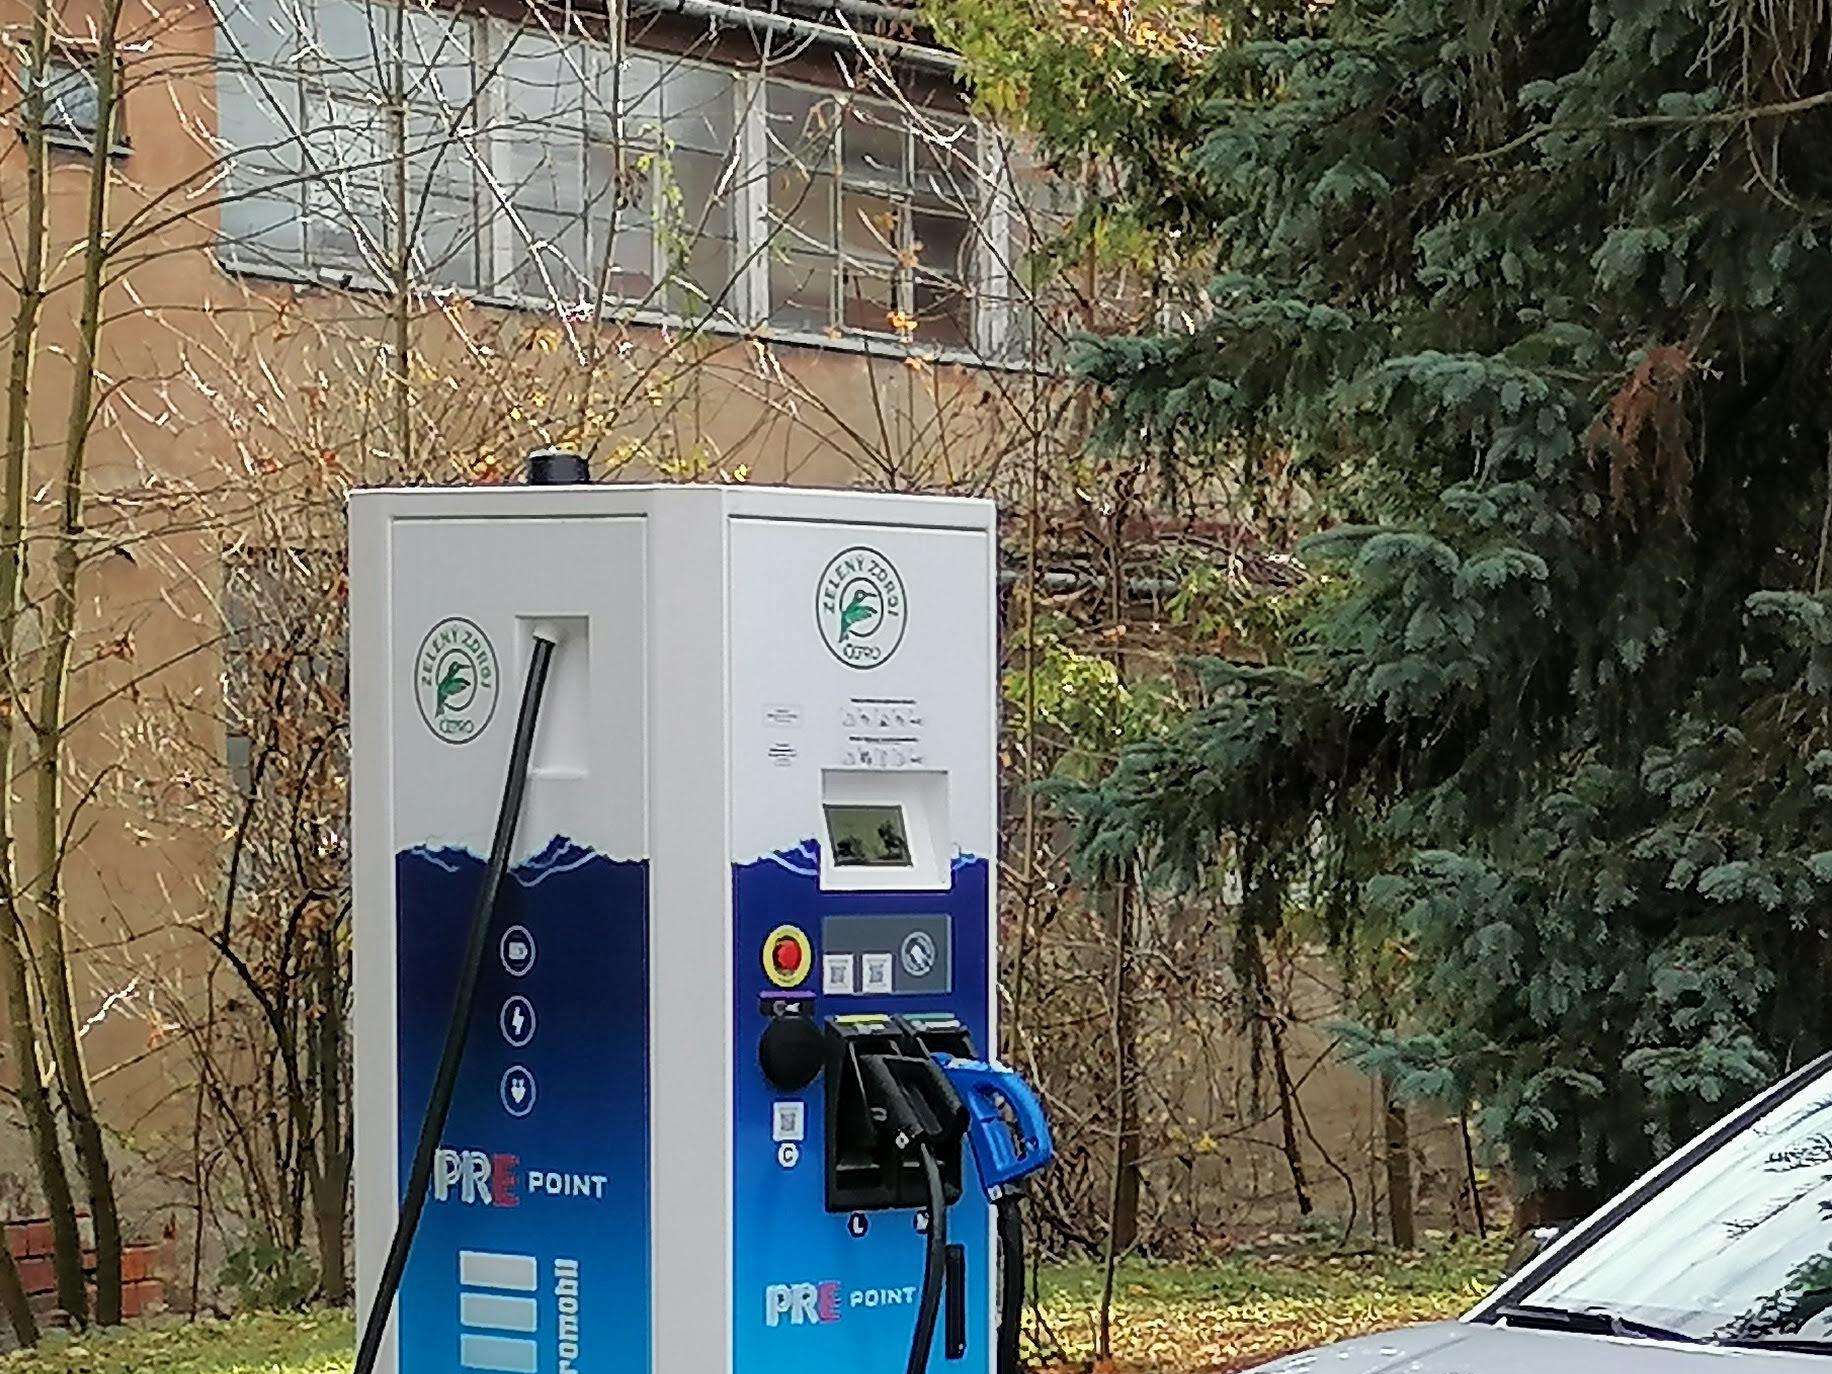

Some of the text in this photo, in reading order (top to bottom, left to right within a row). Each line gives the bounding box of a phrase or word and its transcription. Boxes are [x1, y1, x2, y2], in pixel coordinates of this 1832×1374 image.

[433, 1148, 608, 1208] PRE POINT
[765, 1281, 917, 1327] PRE POINT
